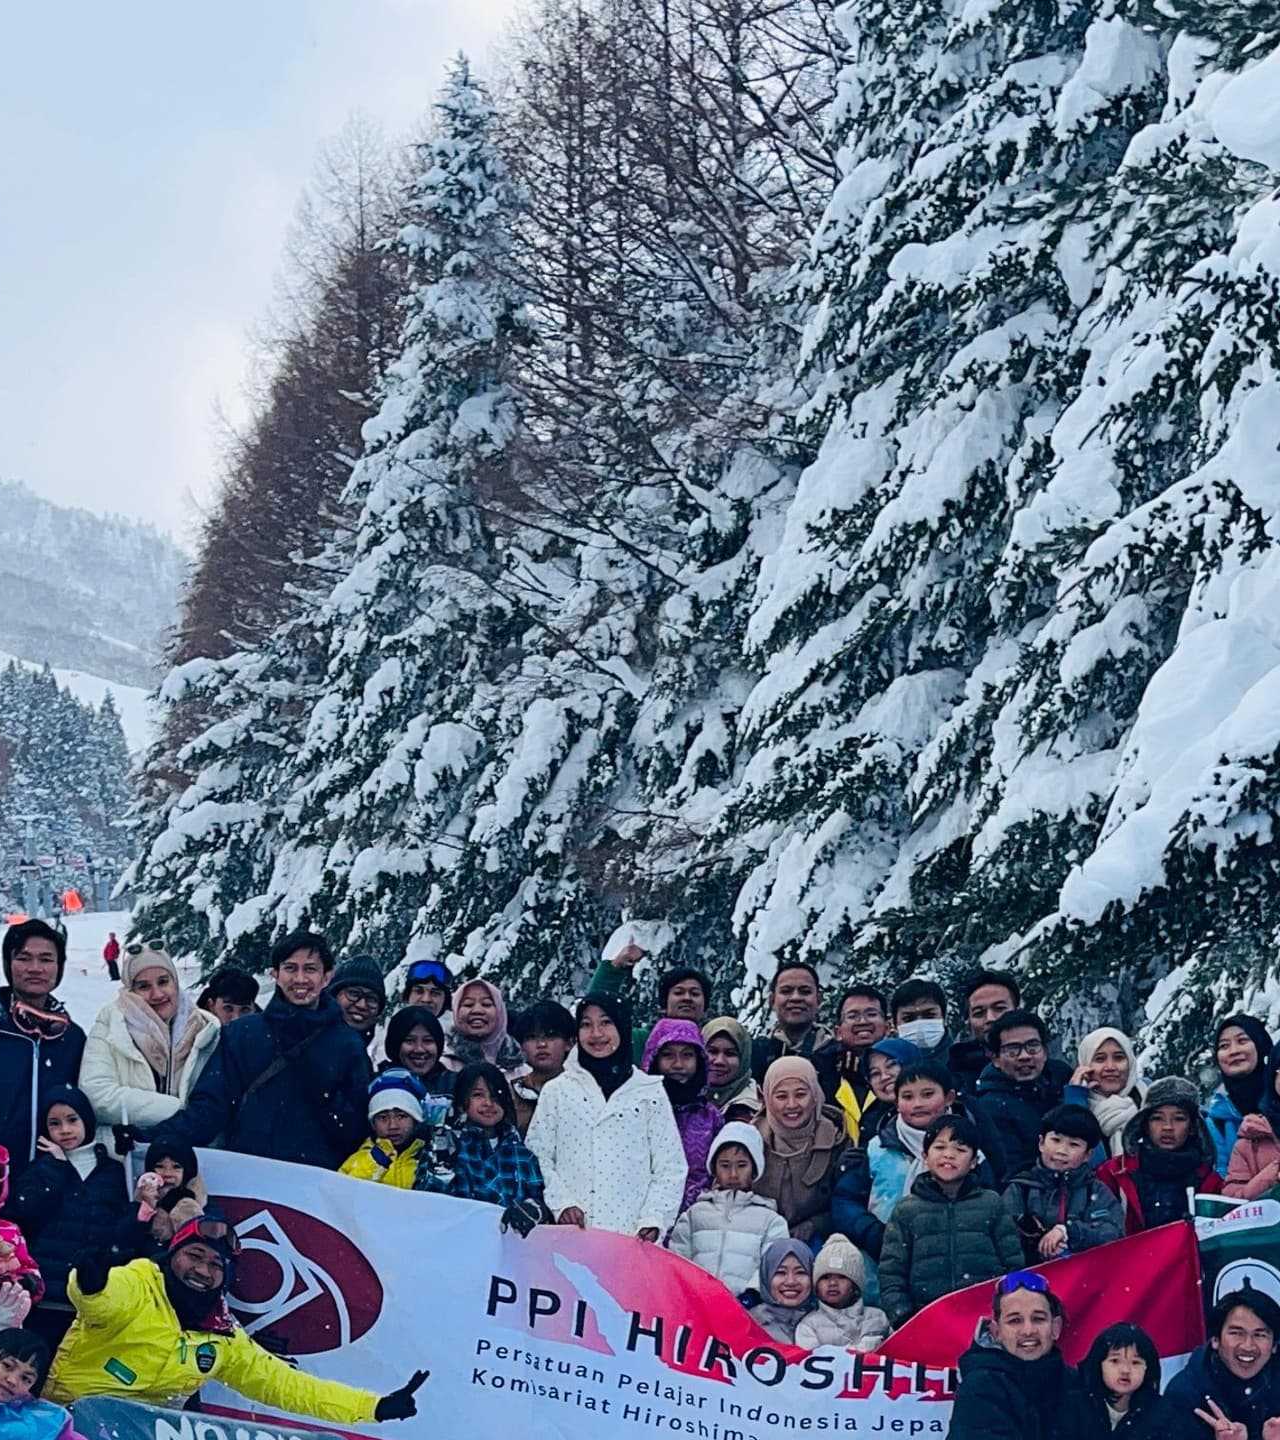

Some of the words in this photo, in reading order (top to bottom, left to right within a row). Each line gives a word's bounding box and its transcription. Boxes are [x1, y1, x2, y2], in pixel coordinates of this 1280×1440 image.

[486, 1275, 587, 1338] PPI
[472, 1368, 611, 1414] Komisariat
[476, 1339, 605, 1384] Persatuan
[618, 1373, 708, 1409] Pelajar
[720, 1398, 858, 1432] Indonesia
[871, 1415, 944, 1437] Jepa
